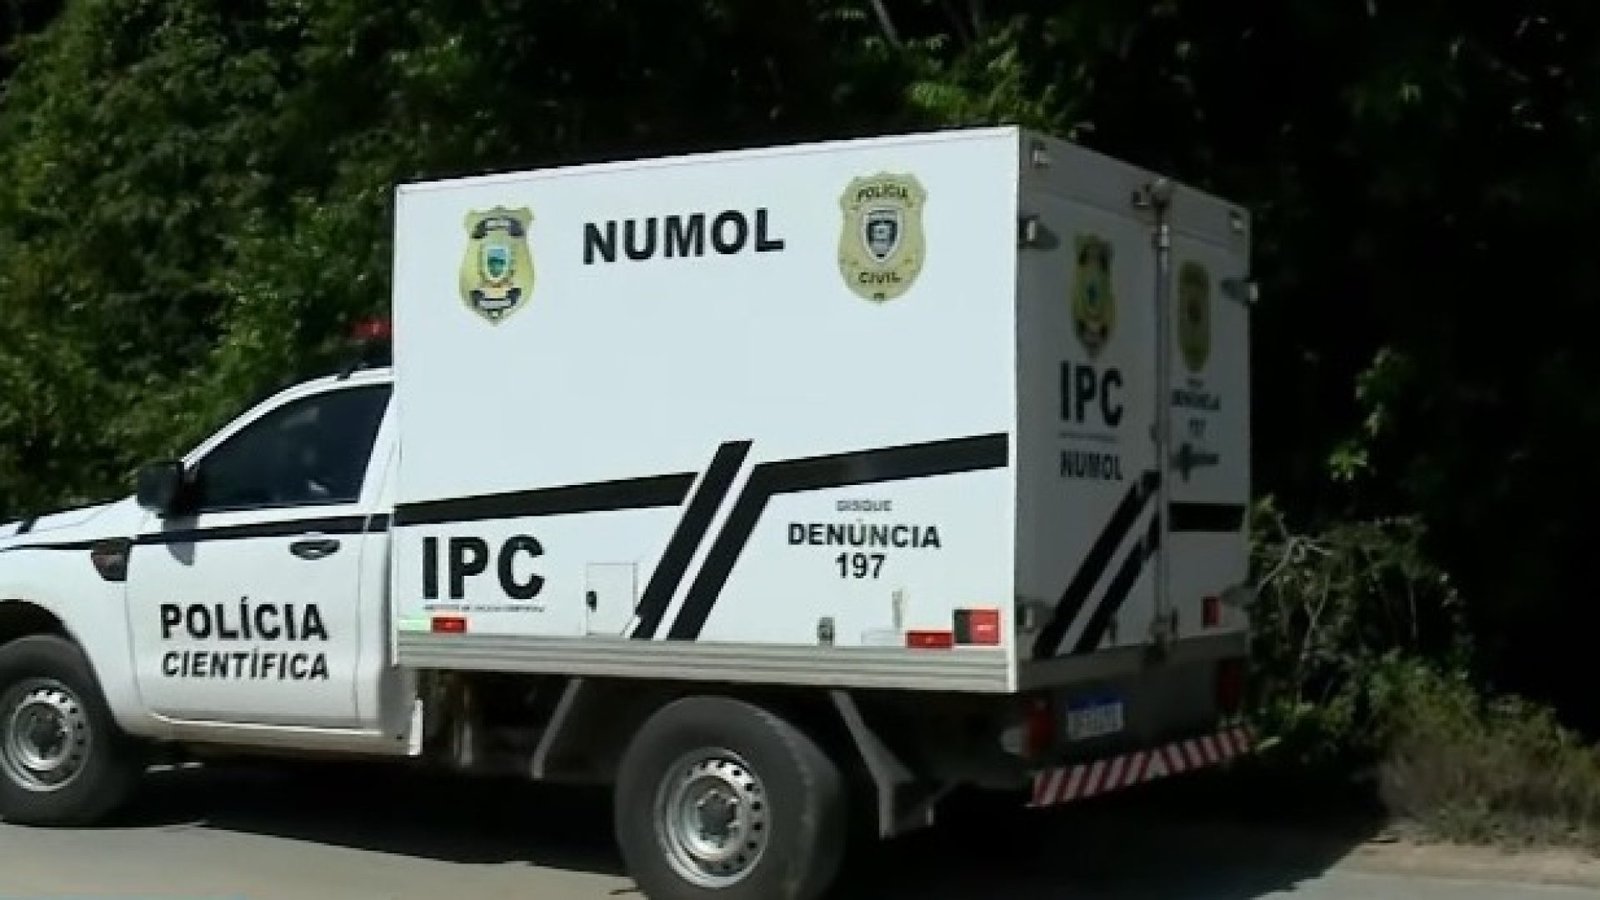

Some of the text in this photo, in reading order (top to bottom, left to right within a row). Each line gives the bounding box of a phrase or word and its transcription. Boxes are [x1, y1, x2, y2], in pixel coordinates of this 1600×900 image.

[583, 208, 785, 265] NUMOL
[858, 271, 902, 284] CIVIL
[1060, 360, 1123, 427] IPC
[1060, 450, 1123, 480] NUMOL
[788, 519, 941, 547] DENÚNCIA
[423, 534, 545, 599] IPC
[835, 552, 886, 578] 197
[160, 596, 328, 641] POLÍCIA
[162, 646, 329, 679] CIENTÍFICA
